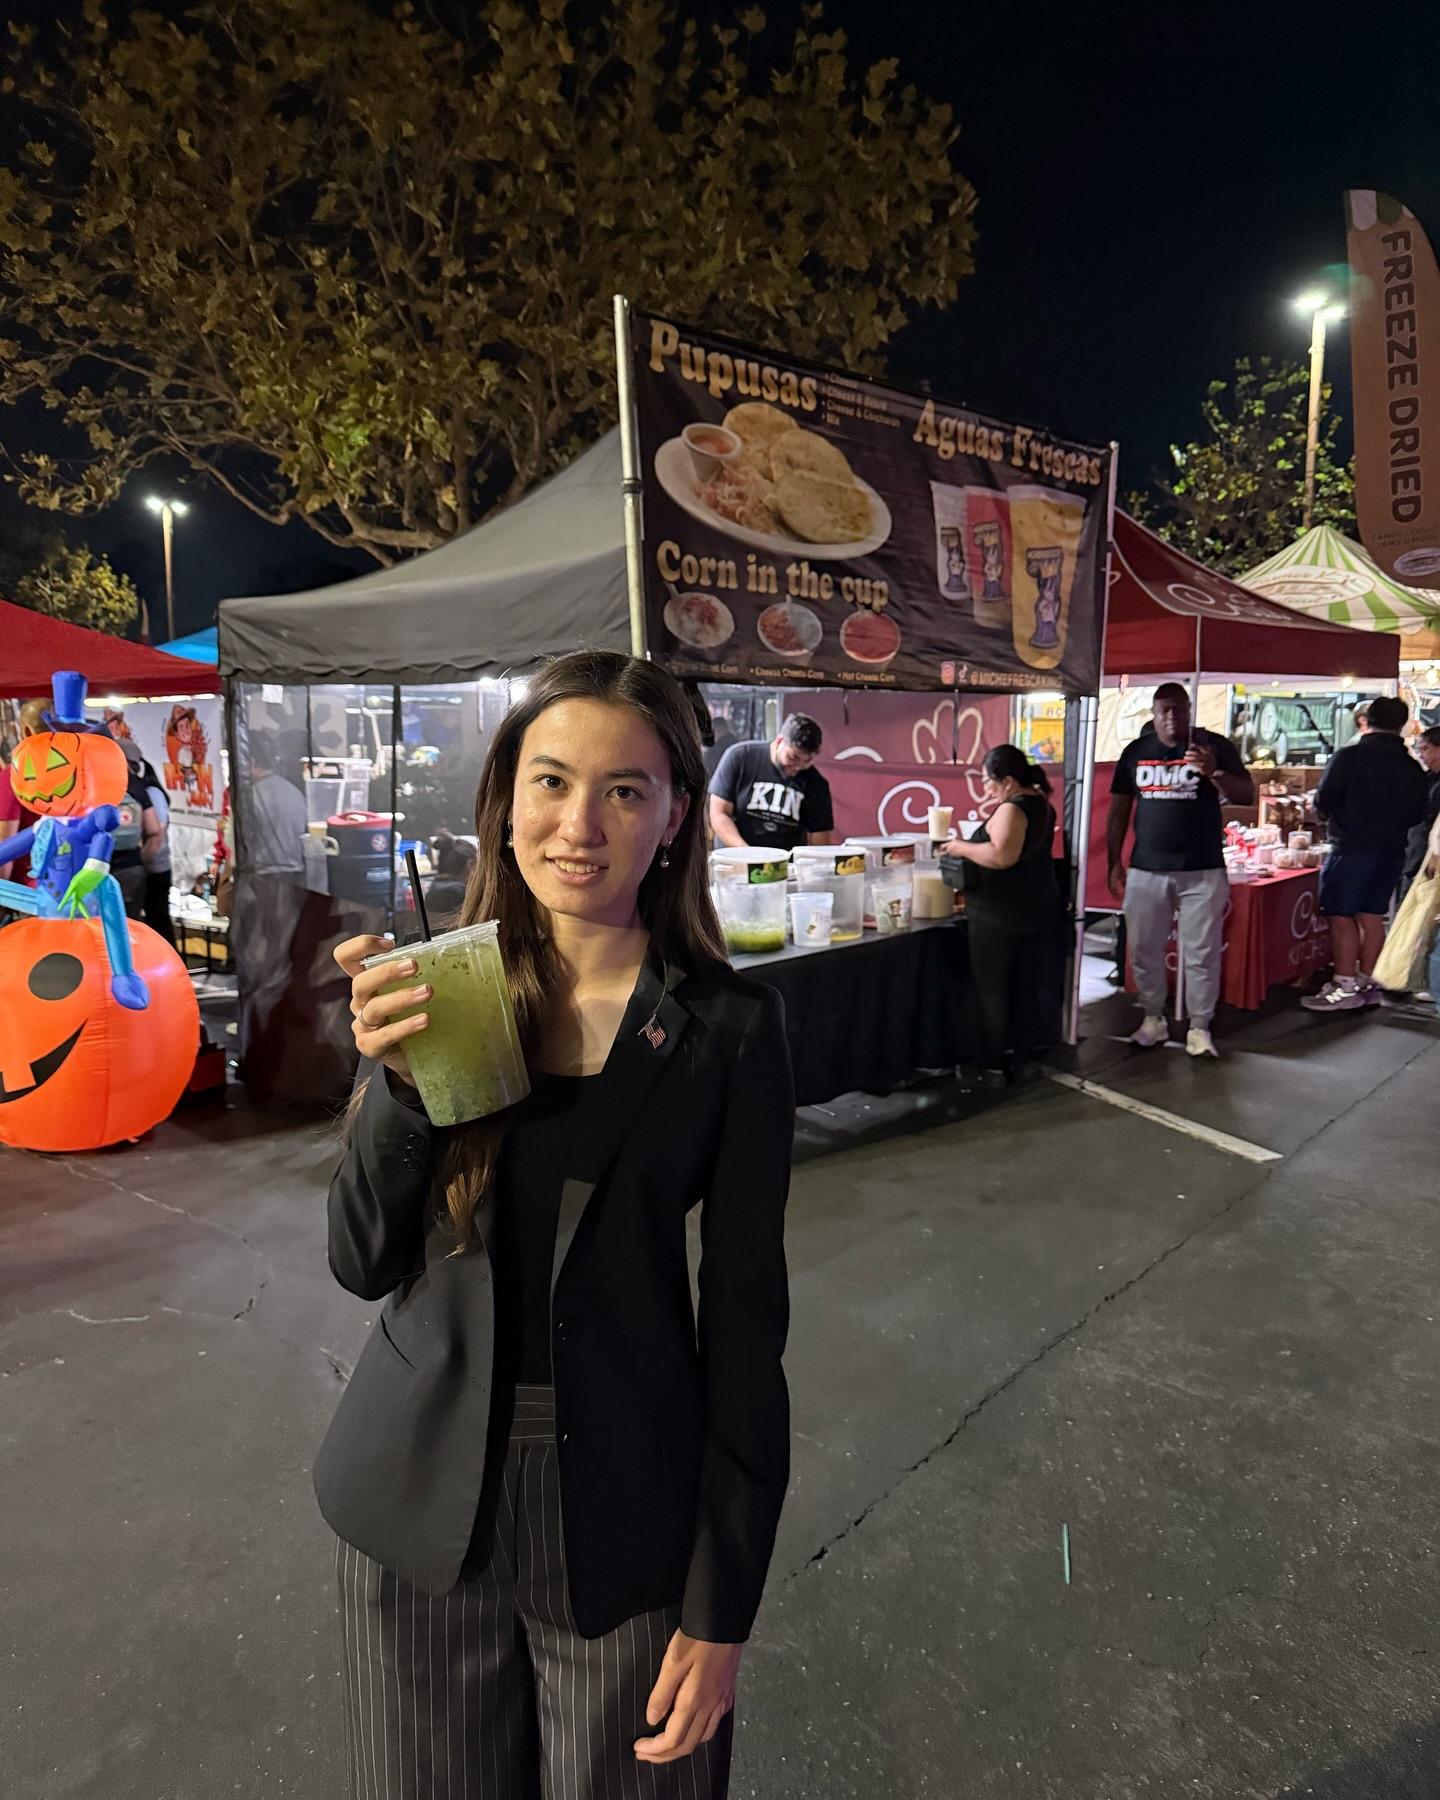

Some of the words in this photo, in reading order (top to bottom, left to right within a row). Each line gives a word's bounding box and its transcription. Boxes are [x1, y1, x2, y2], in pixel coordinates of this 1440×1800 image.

[1381, 229, 1418, 391] FREEZE
[649, 319, 817, 412] Pupusas
[913, 399, 1004, 462] Aguas
[1011, 425, 1100, 485] Frescas
[1388, 396, 1422, 524] DRIED
[657, 540, 738, 590] Corn
[746, 553, 778, 593] in
[785, 560, 834, 600] the
[840, 575, 889, 613] cup
[1136, 764, 1200, 787] DMC
